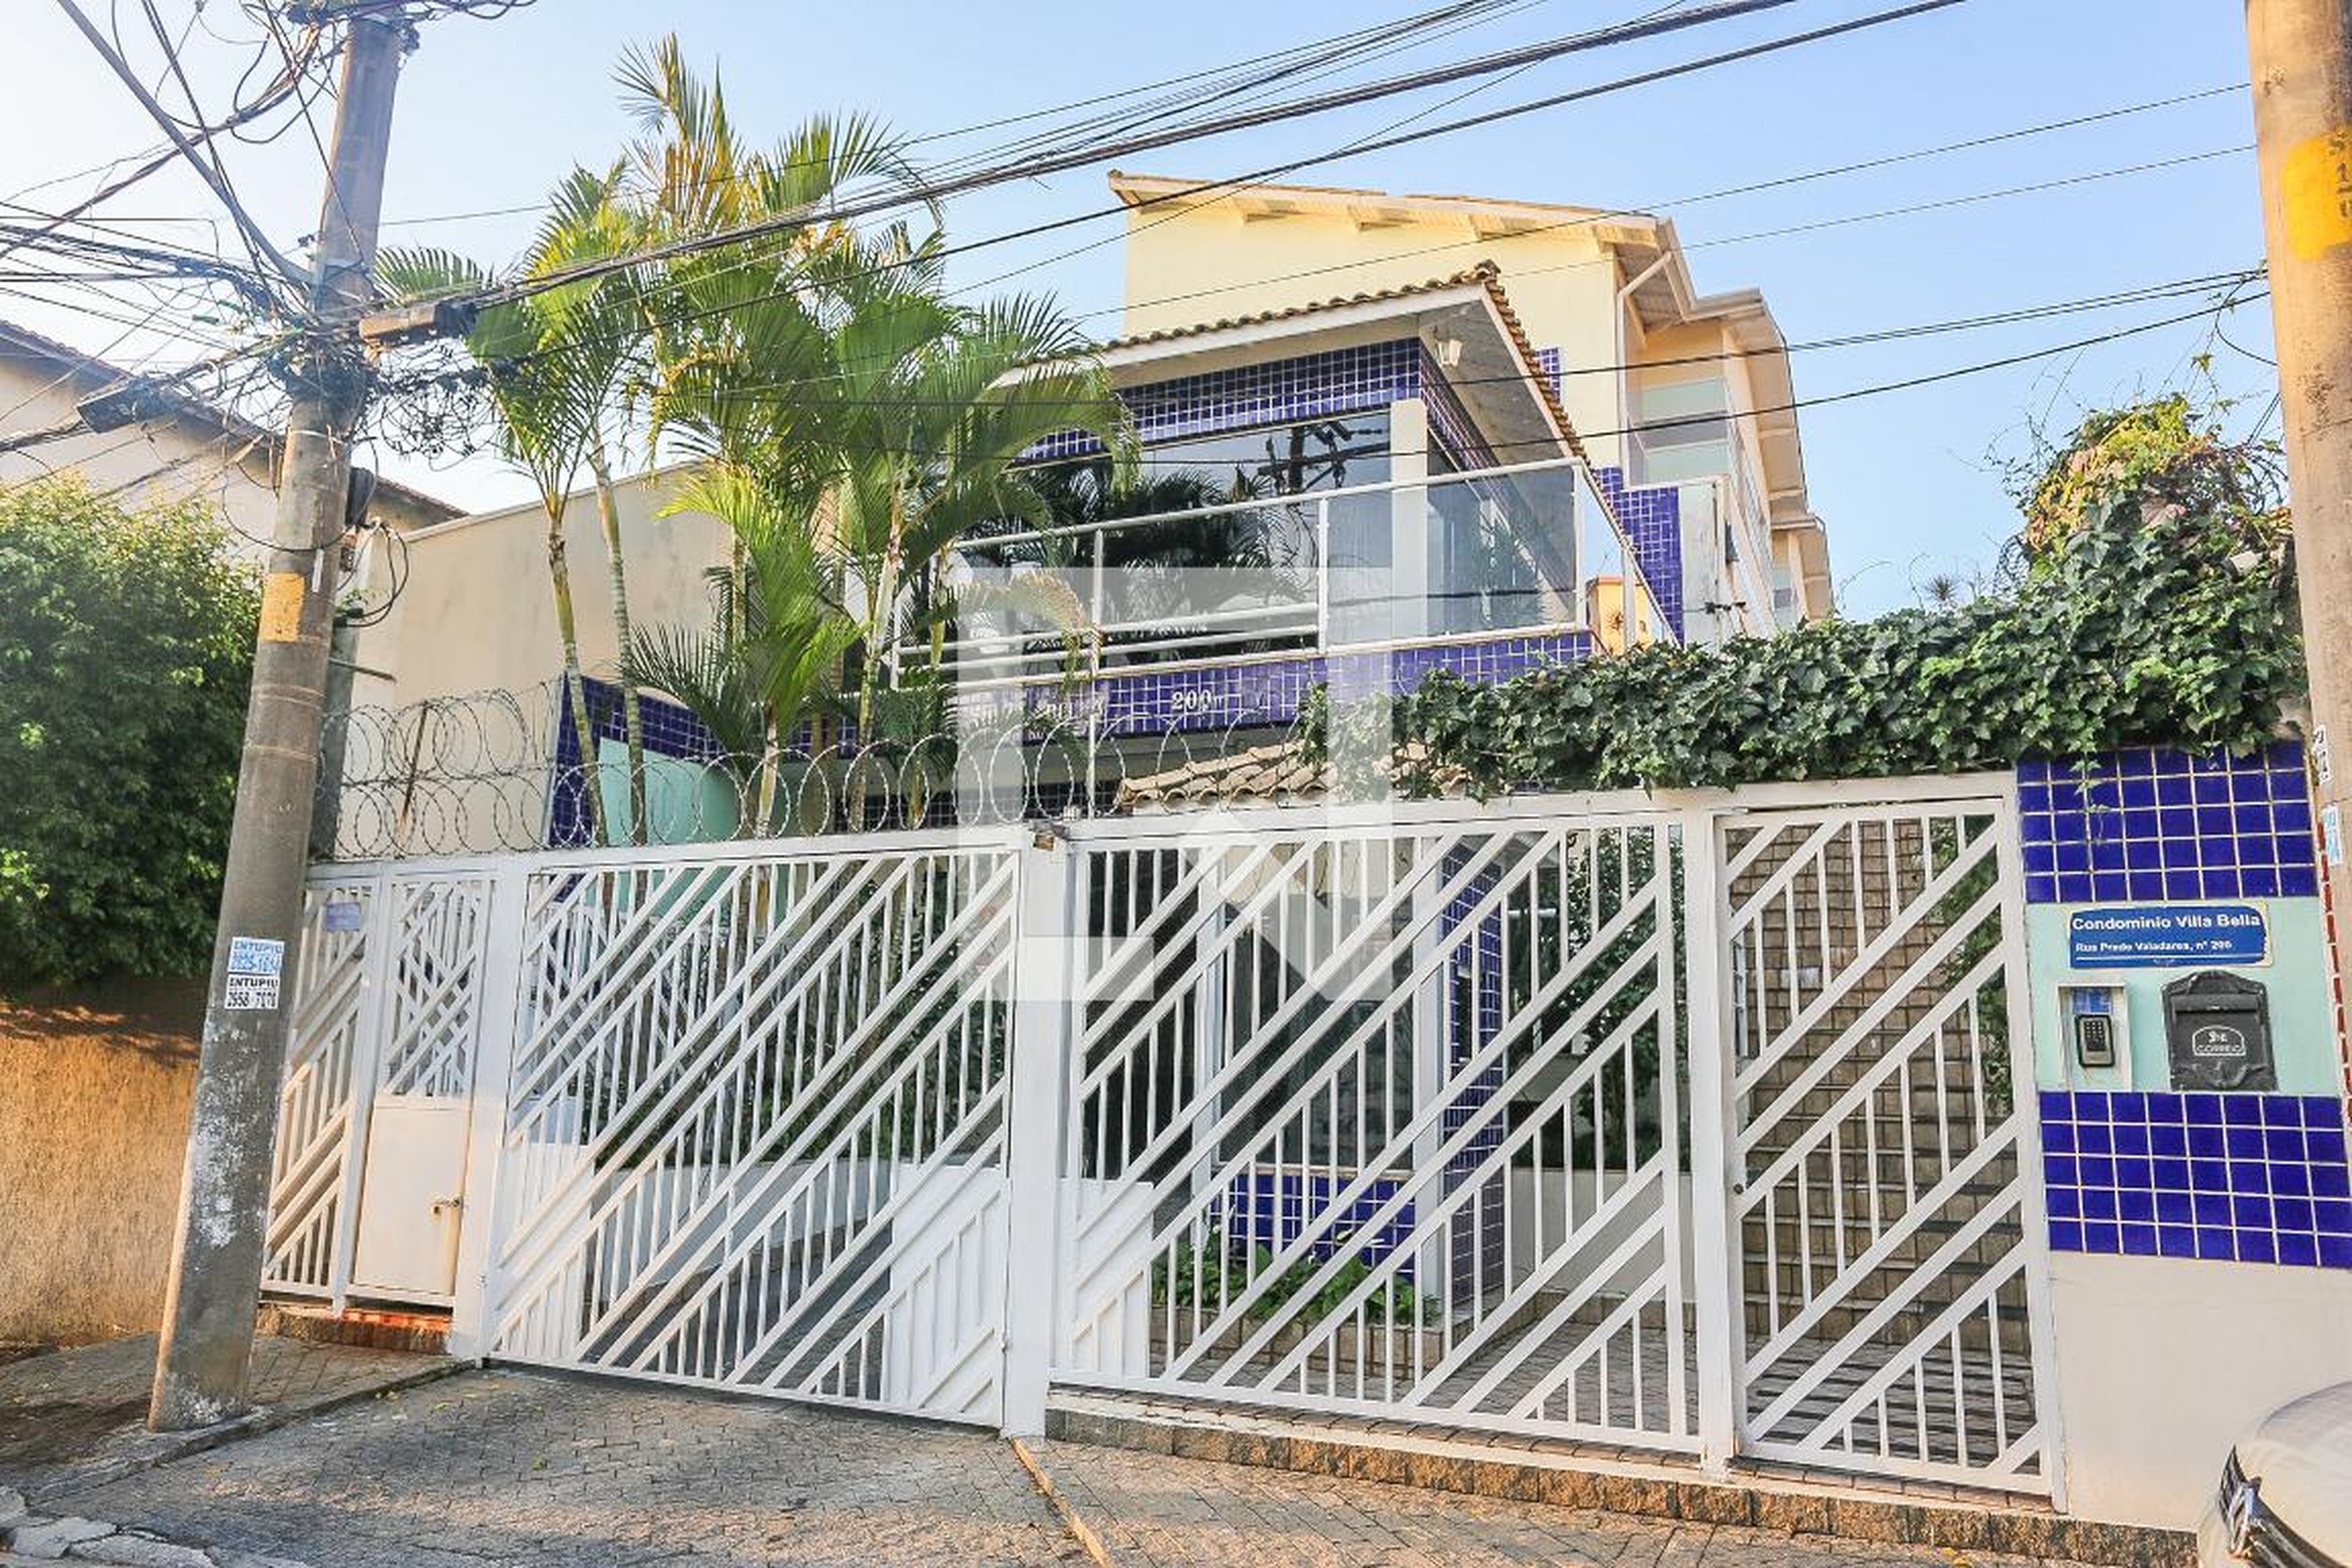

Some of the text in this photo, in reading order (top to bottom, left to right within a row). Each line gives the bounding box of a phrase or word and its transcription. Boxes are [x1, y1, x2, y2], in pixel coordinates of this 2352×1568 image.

[2176, 914, 2212, 927] Villa
[2217, 913, 2261, 927] Bella
[2075, 942, 2098, 952] Rua
